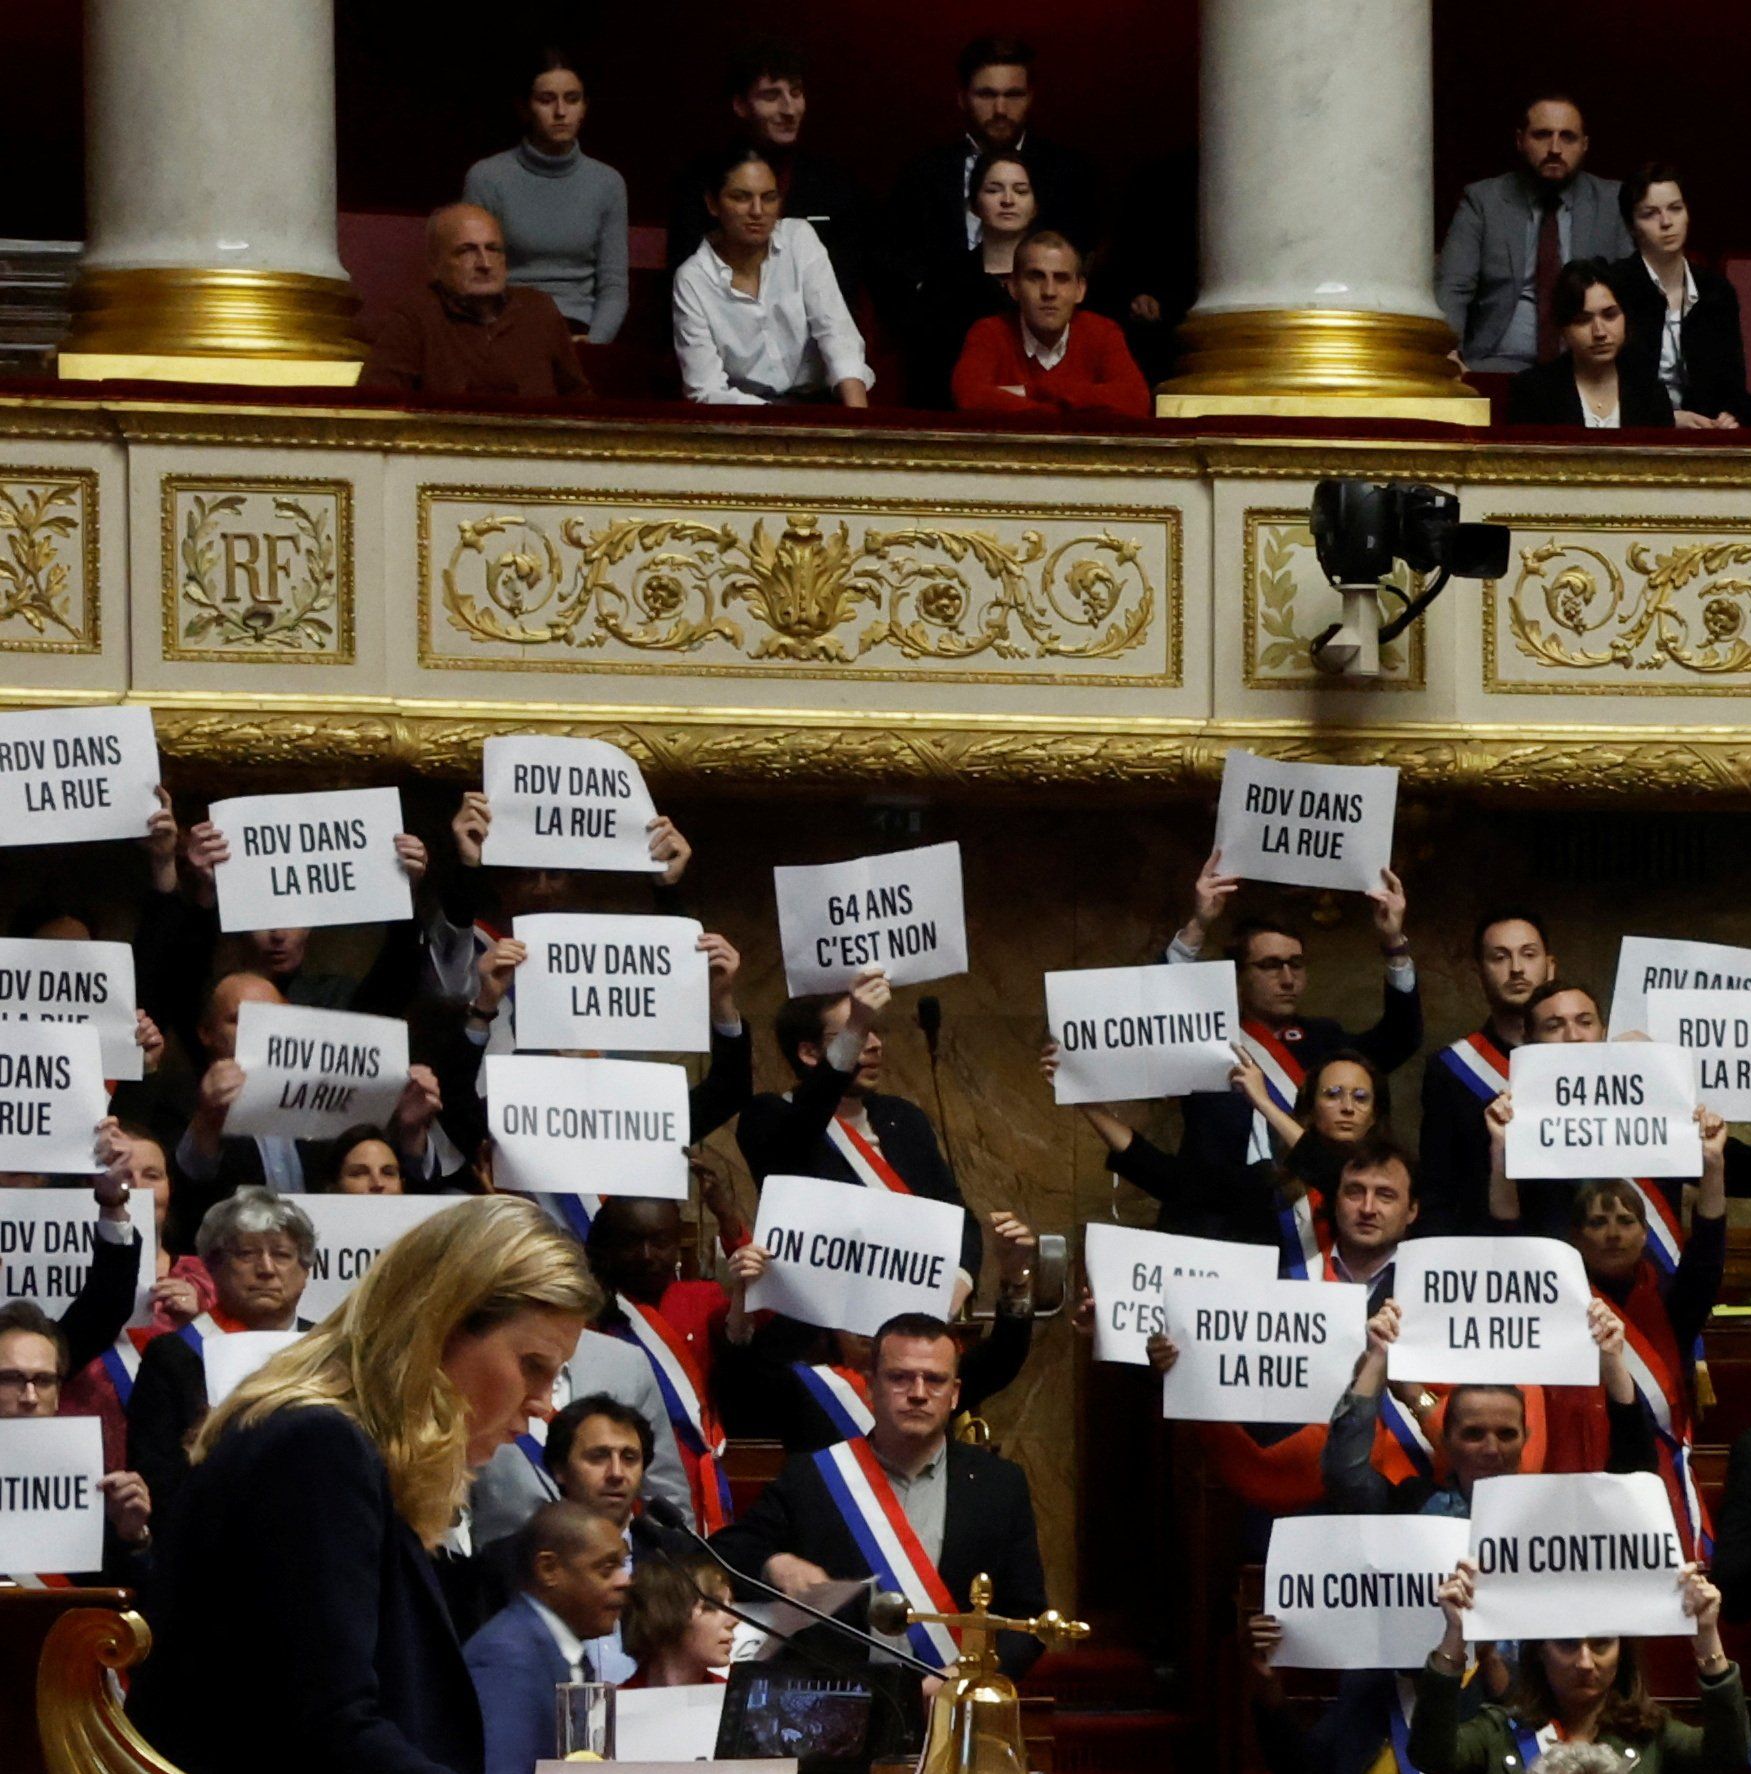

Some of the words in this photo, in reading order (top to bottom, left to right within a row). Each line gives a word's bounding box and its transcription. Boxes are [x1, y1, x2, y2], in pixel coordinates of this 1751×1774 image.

[220, 532, 300, 605] RF
[0, 740, 44, 772] RDV
[53, 735, 121, 768] DANS
[25, 782, 56, 811] LA
[62, 778, 111, 809] RUE
[515, 765, 561, 794] RDV
[569, 767, 630, 798] DANS
[1246, 784, 1294, 815] RDV
[1299, 790, 1362, 823] DANS
[244, 825, 290, 856] RDV
[300, 820, 366, 852] DANS
[536, 806, 562, 835] LA
[571, 808, 615, 838] RUE
[1262, 825, 1289, 854] LA
[1297, 829, 1343, 859] RUE
[271, 866, 301, 896] LA
[307, 862, 355, 894] RUE
[829, 894, 859, 925] 64
[867, 885, 912, 920] ANS
[548, 944, 596, 973] RDV
[605, 945, 671, 975] DANS
[816, 931, 880, 968] C'EST
[888, 921, 936, 958] NON
[572, 986, 600, 1016] LA
[609, 987, 656, 1017] RUE
[1063, 1021, 1096, 1051] ON
[1105, 1011, 1227, 1048] CONTINUE
[1556, 1077, 1586, 1106] 64
[1595, 1074, 1643, 1105] ANS
[504, 1105, 537, 1135] ON
[547, 1107, 675, 1141] CONTINUE
[1540, 1118, 1606, 1147] C'EST
[1616, 1117, 1667, 1146] NON
[766, 1226, 803, 1263] ON
[810, 1235, 944, 1289] CONTINUE
[1425, 1271, 1477, 1303] RDV
[1487, 1271, 1558, 1304] DANS
[1197, 1310, 1248, 1341] RDV
[1257, 1312, 1326, 1344] DANS
[1450, 1317, 1479, 1348] LA
[1490, 1317, 1540, 1348] RUE
[1220, 1355, 1249, 1386] LA
[1259, 1356, 1307, 1387] RUE
[1479, 1538, 1518, 1574] ON
[1529, 1534, 1678, 1573] CONTINUE
